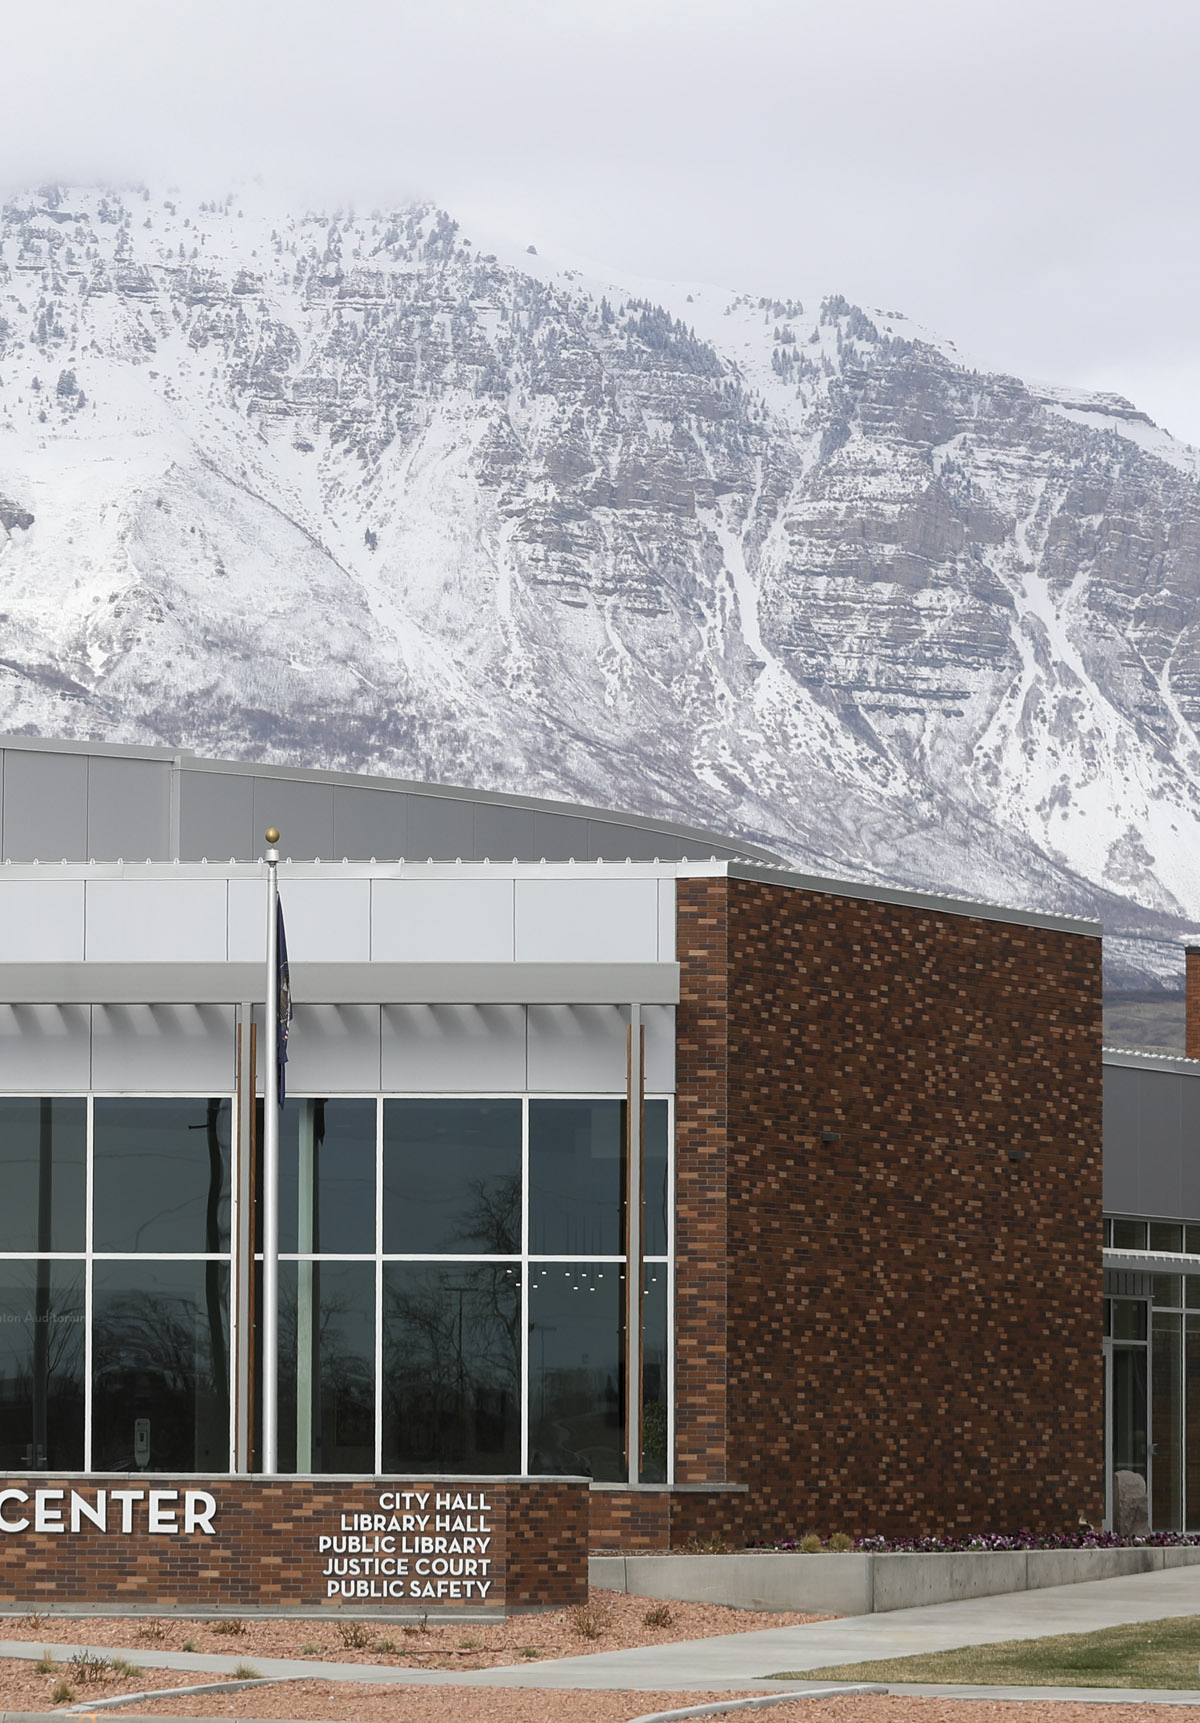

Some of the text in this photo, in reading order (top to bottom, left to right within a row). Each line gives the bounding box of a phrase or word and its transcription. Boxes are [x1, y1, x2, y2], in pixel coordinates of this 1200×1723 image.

[379, 1492, 492, 1510] CITY HALL
[341, 1514, 491, 1532] LIBRARY HALL
[319, 1535, 491, 1554] PUBLIC LIBRARY
[322, 1557, 491, 1576] JUSTICE COURT
[327, 1580, 491, 1598] PUBLIC SAFETY
